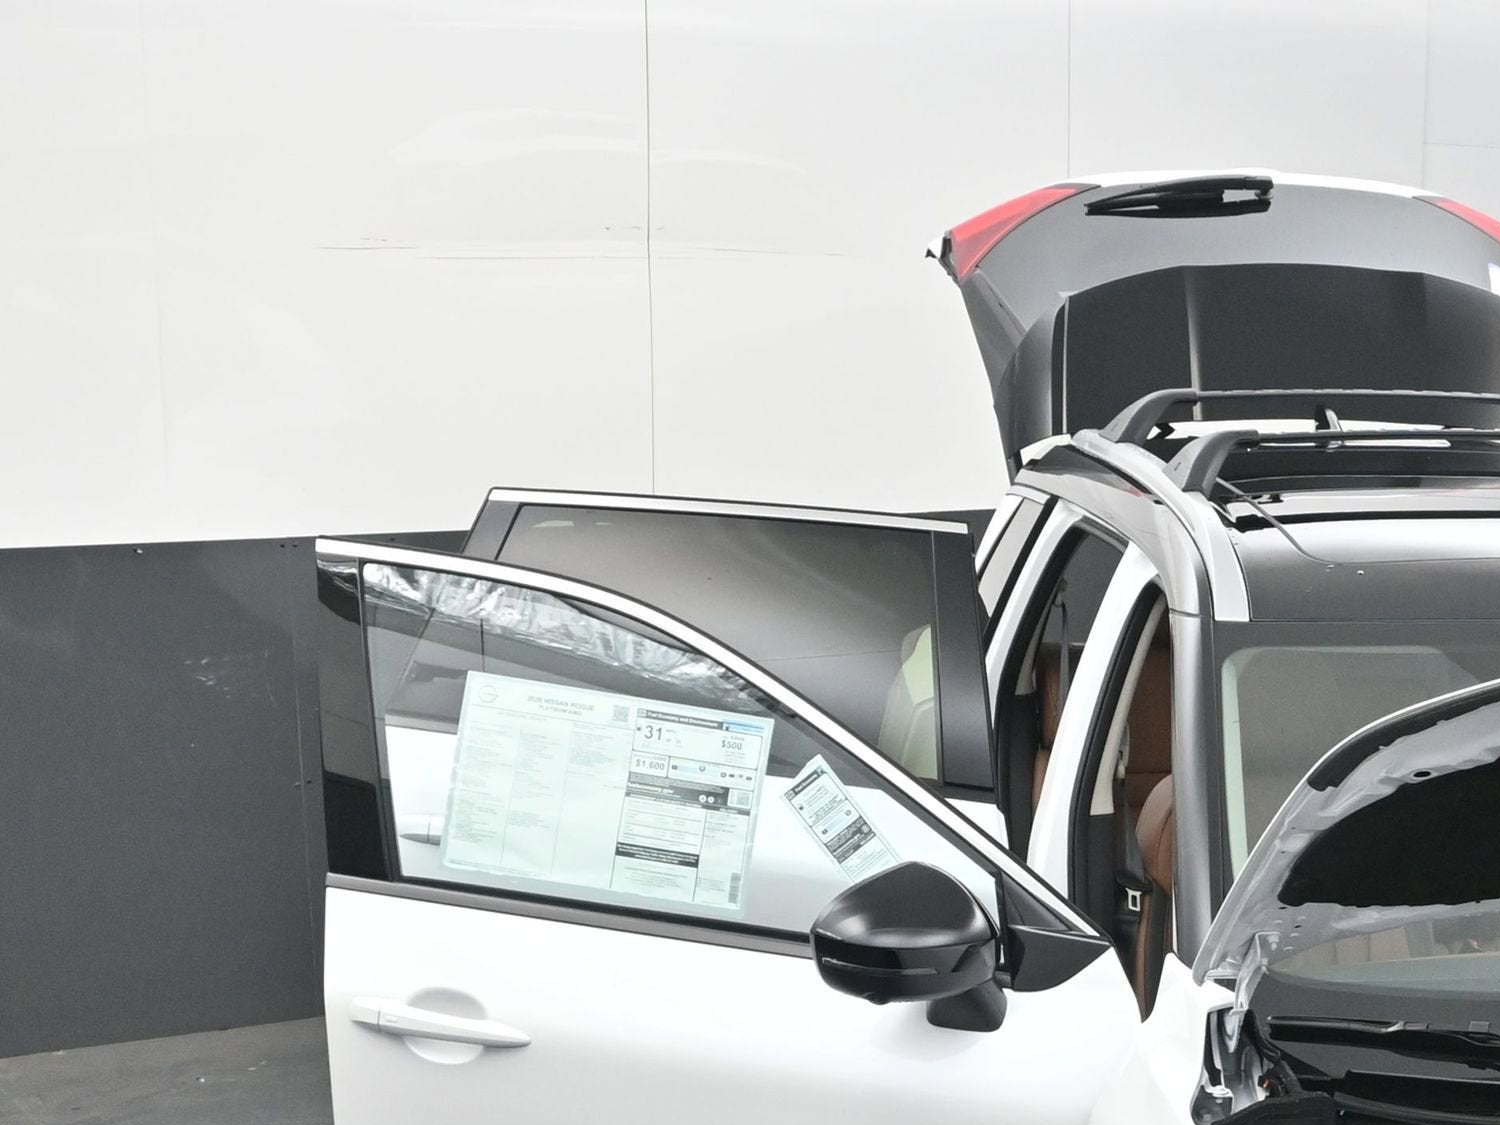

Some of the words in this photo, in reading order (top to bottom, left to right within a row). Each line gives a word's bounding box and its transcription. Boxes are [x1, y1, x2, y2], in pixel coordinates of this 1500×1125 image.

[644, 724, 662, 741] 31
[721, 740, 743, 751] $500
[635, 758, 665, 771] $1,600
